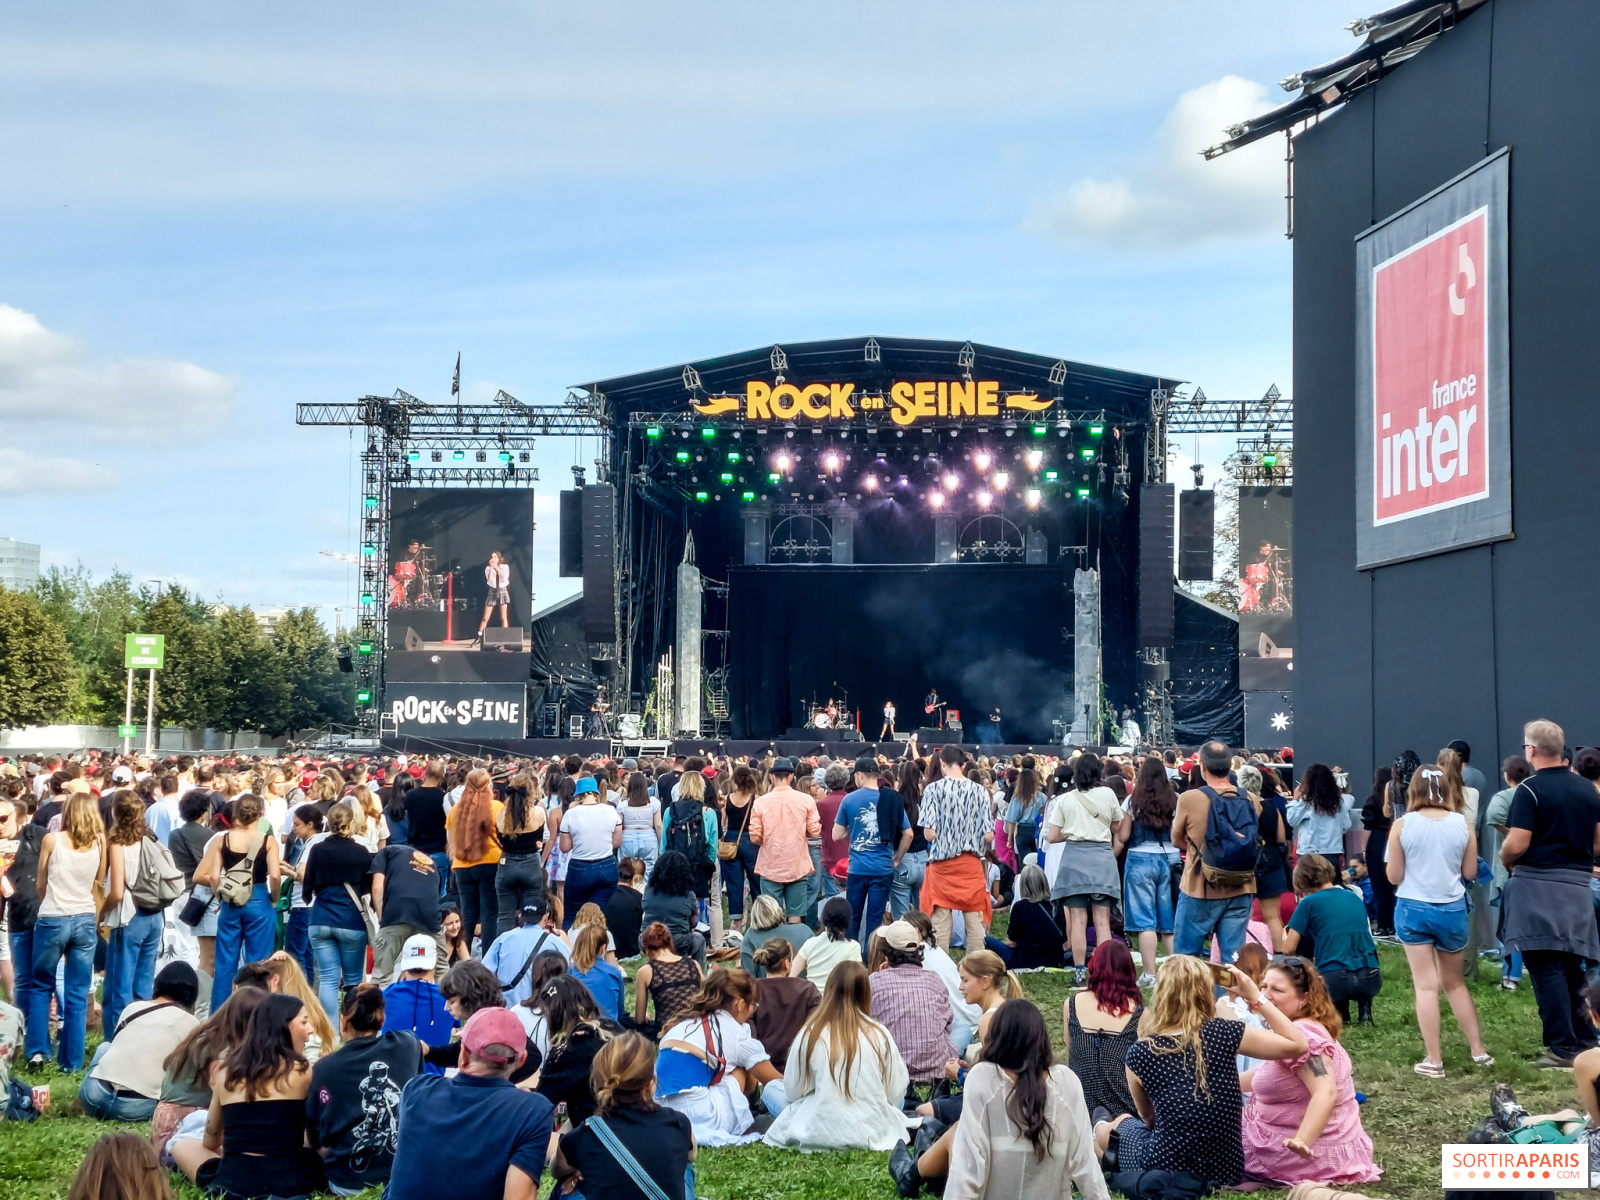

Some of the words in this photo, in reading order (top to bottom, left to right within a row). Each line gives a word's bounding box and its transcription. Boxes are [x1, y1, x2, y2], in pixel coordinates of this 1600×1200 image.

[747, 381, 855, 419] ROCK
[860, 396, 884, 410] en
[891, 381, 999, 426] SEINE
[1432, 373, 1477, 410] france
[1382, 404, 1477, 499] inter
[392, 695, 448, 724] ROCK
[444, 705, 456, 716] EN
[456, 698, 519, 725] SEINE
